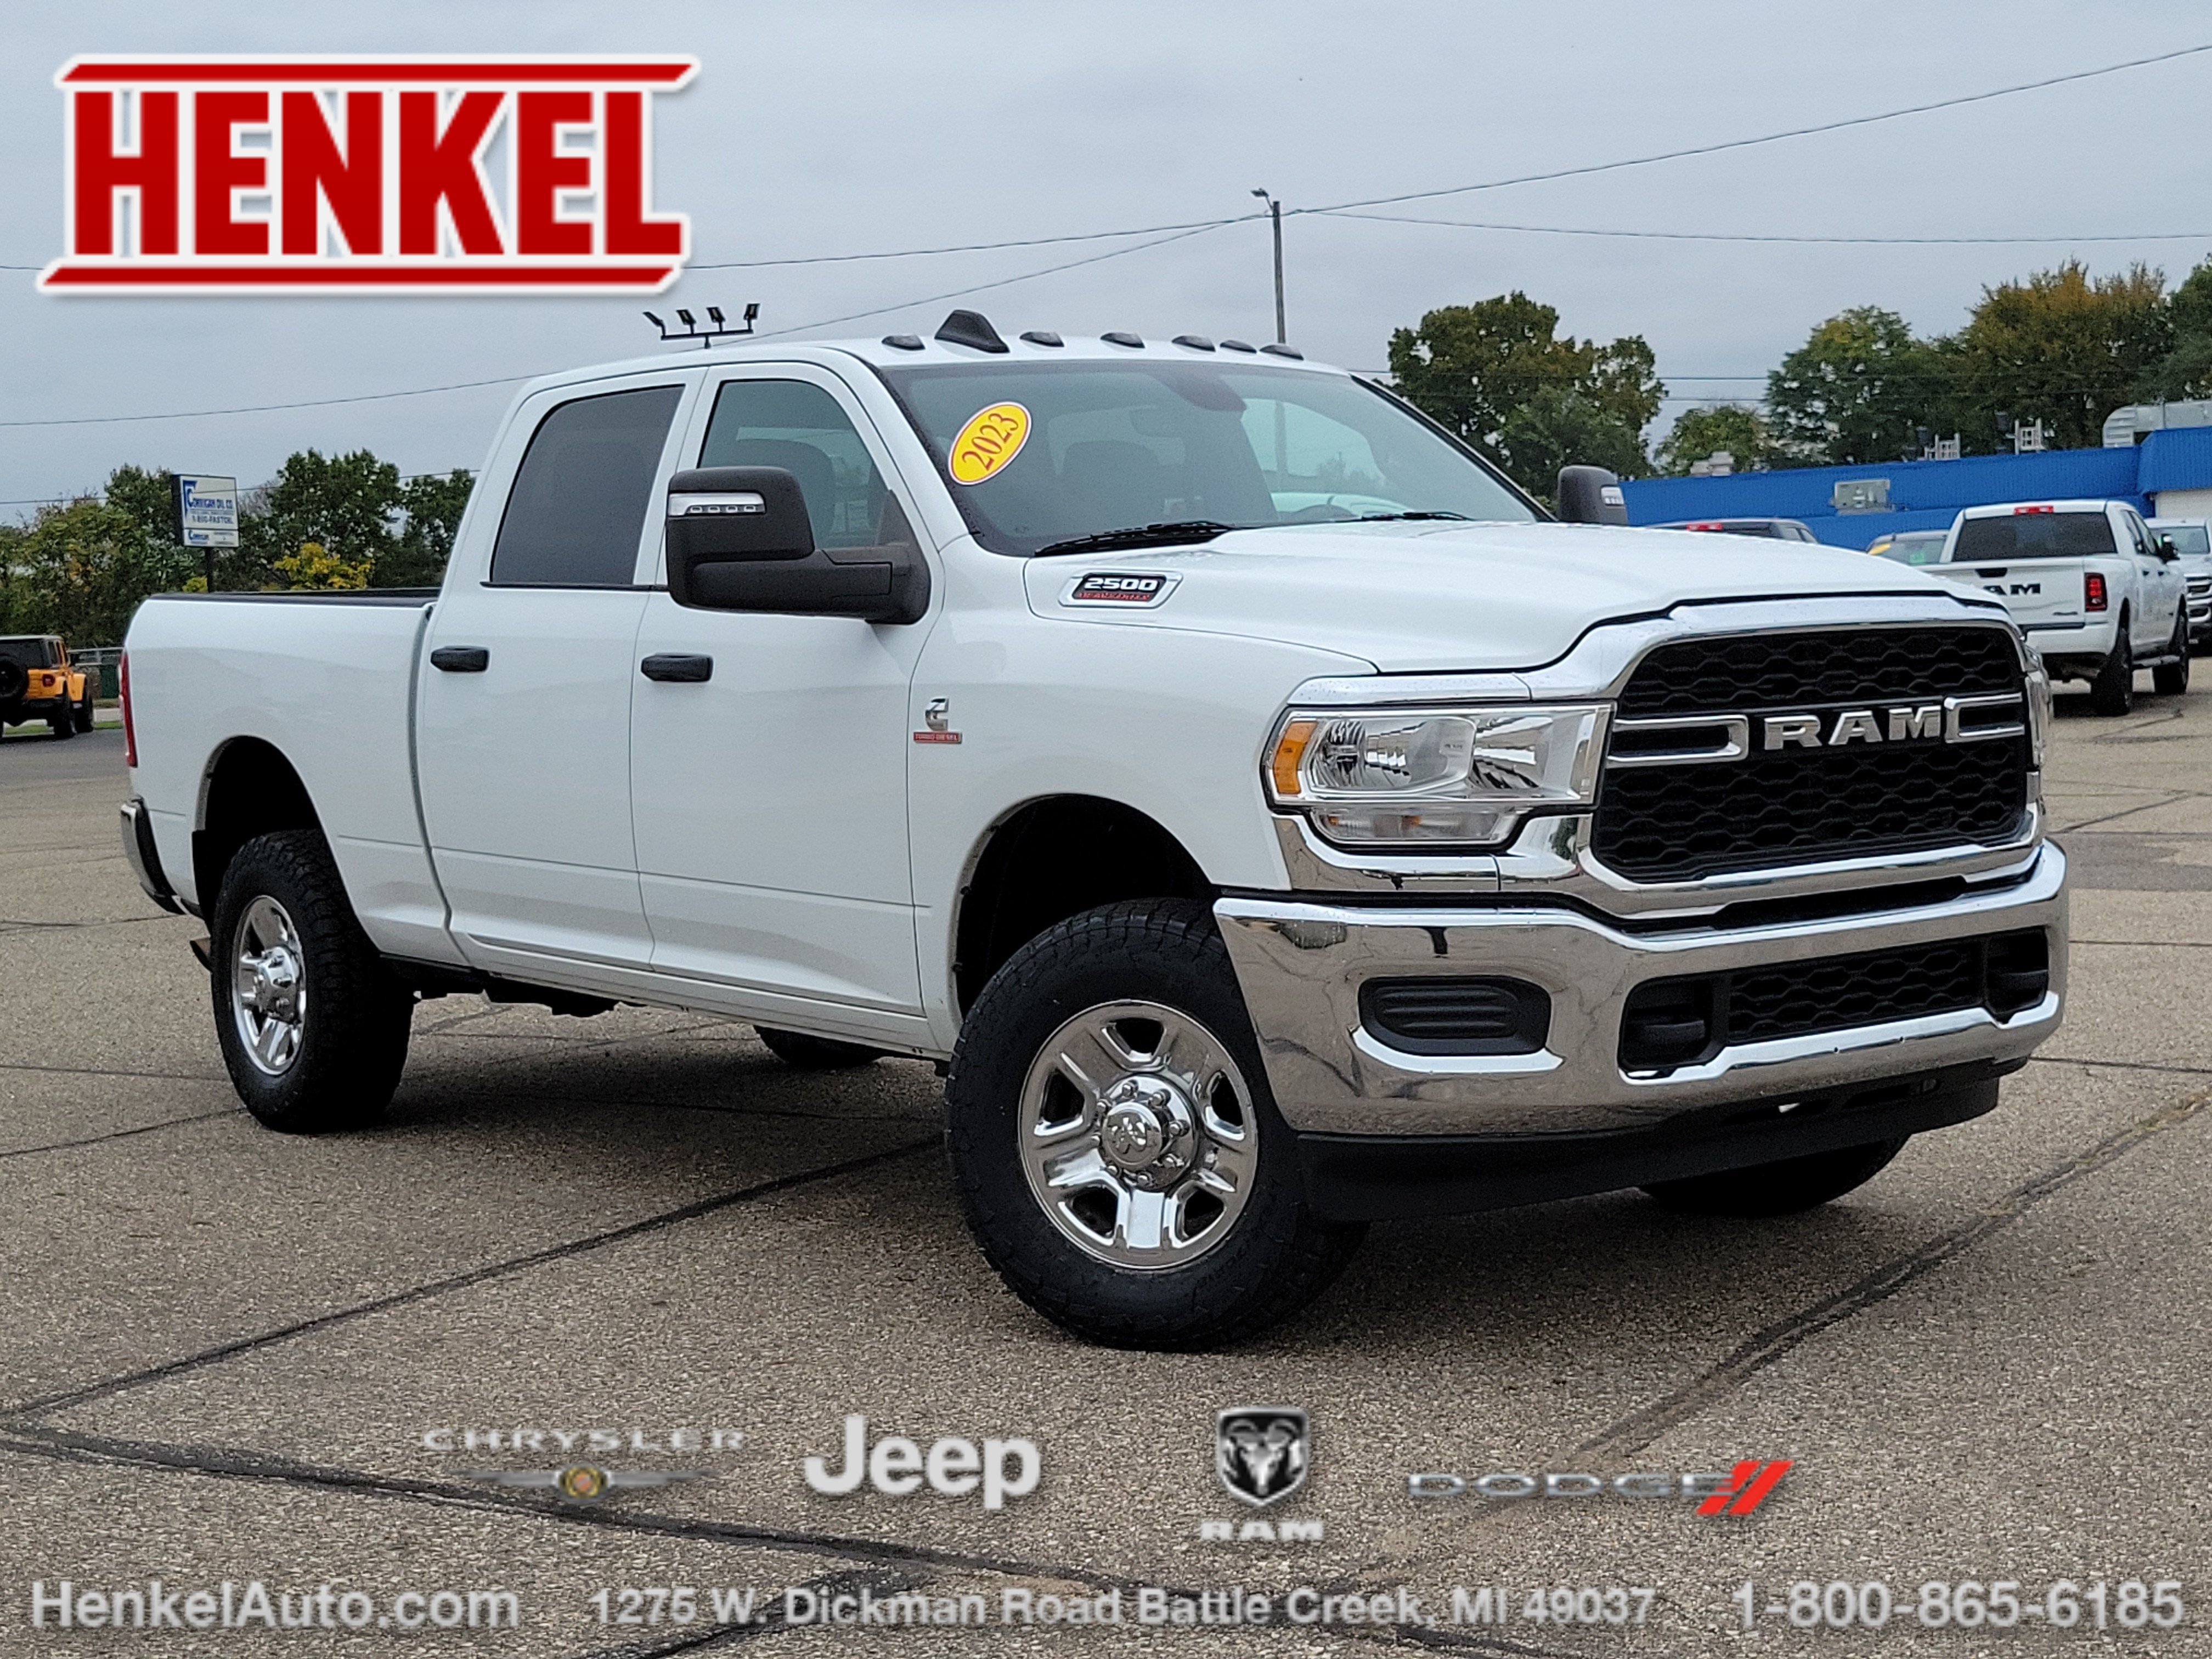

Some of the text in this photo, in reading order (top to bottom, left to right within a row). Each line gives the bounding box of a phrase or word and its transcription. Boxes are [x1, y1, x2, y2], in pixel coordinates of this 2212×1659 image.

[962, 413, 1018, 471] 2023
[1084, 577, 1158, 591] 2500
[1983, 583, 2040, 596] AM
[1764, 706, 1941, 751] RAM
